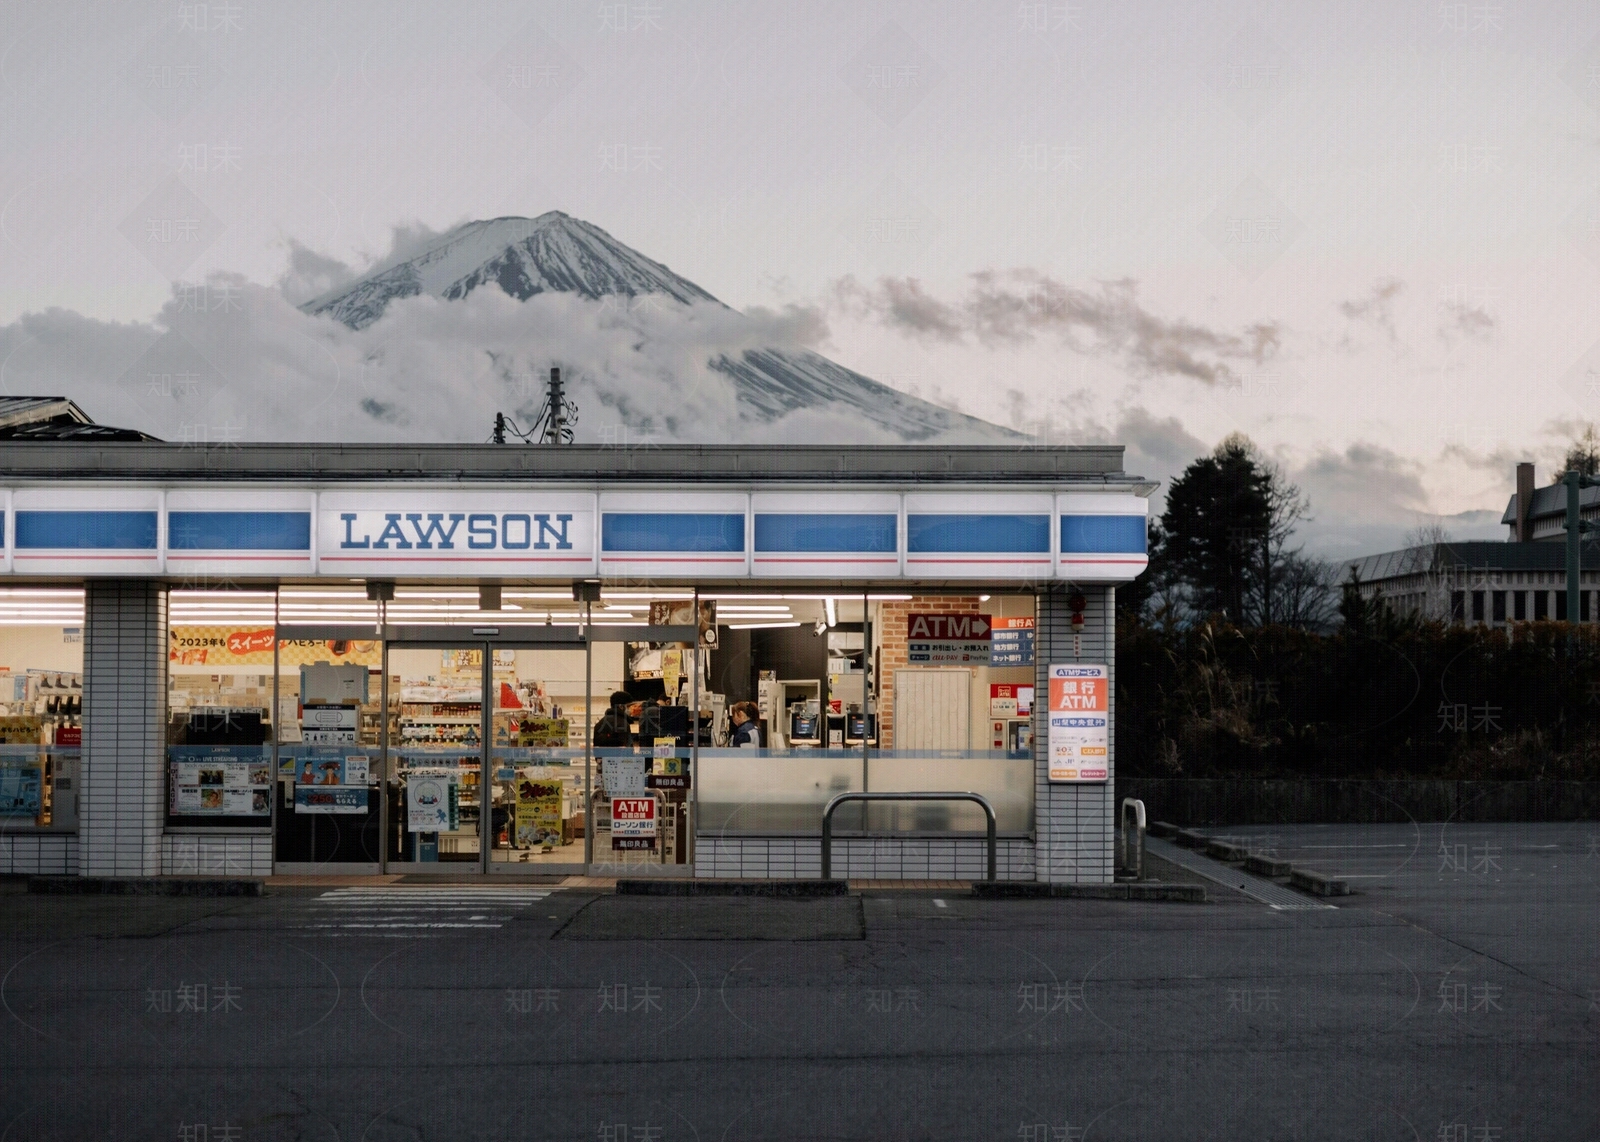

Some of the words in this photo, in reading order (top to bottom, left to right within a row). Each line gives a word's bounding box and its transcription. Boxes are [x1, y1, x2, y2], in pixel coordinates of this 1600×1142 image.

[340, 513, 573, 550] LAWSON
[910, 616, 970, 637] ATM
[180, 637, 226, 647] 2023年も
[230, 635, 274, 651] スイーツ
[1058, 669, 1100, 677] ATMサービス
[1063, 681, 1095, 695] 銀行
[1059, 696, 1097, 709] ATM
[1053, 718, 1104, 727] 山梨中央銀行
[655, 778, 685, 786] 無印良品
[312, 794, 332, 804] 250
[617, 801, 649, 812] ATM
[613, 821, 654, 829] ローソン銀行
[619, 840, 649, 848] 無印良品
